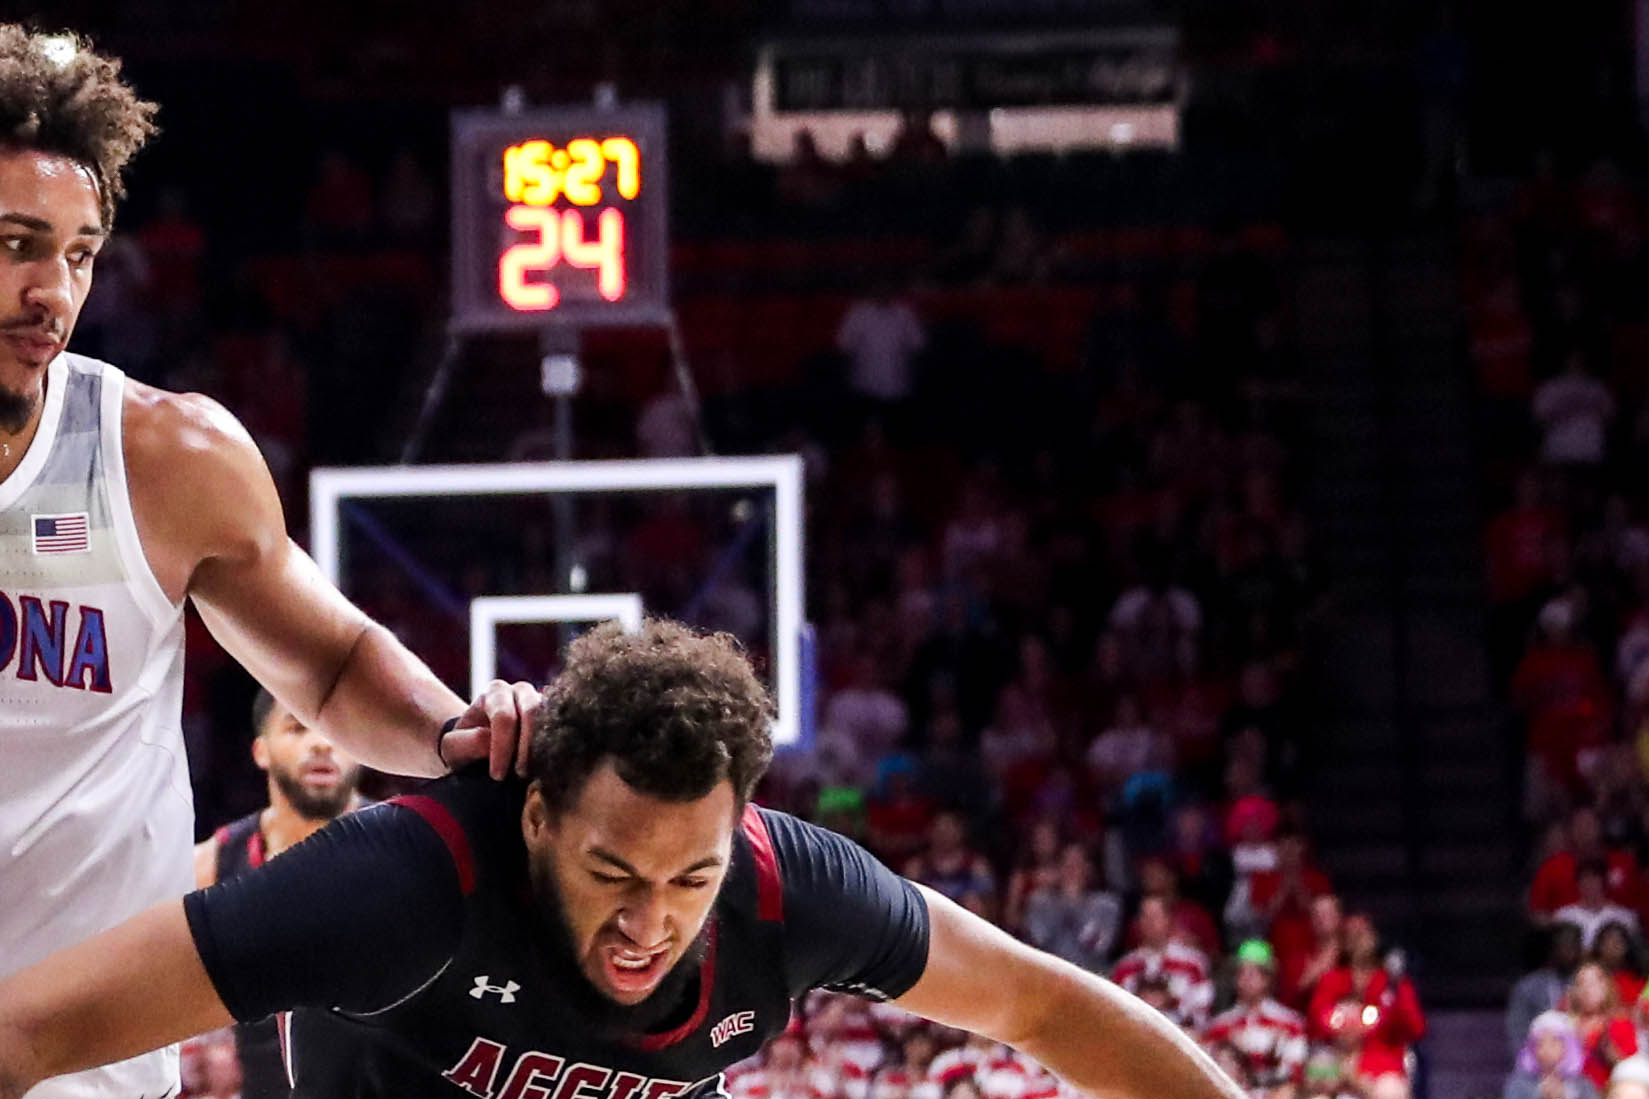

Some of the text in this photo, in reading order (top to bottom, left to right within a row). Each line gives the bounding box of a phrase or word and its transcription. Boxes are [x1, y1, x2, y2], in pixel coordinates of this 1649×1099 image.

[504, 137, 640, 206] 15:27
[500, 206, 625, 311] 24
[710, 1011, 755, 1047] WAC
